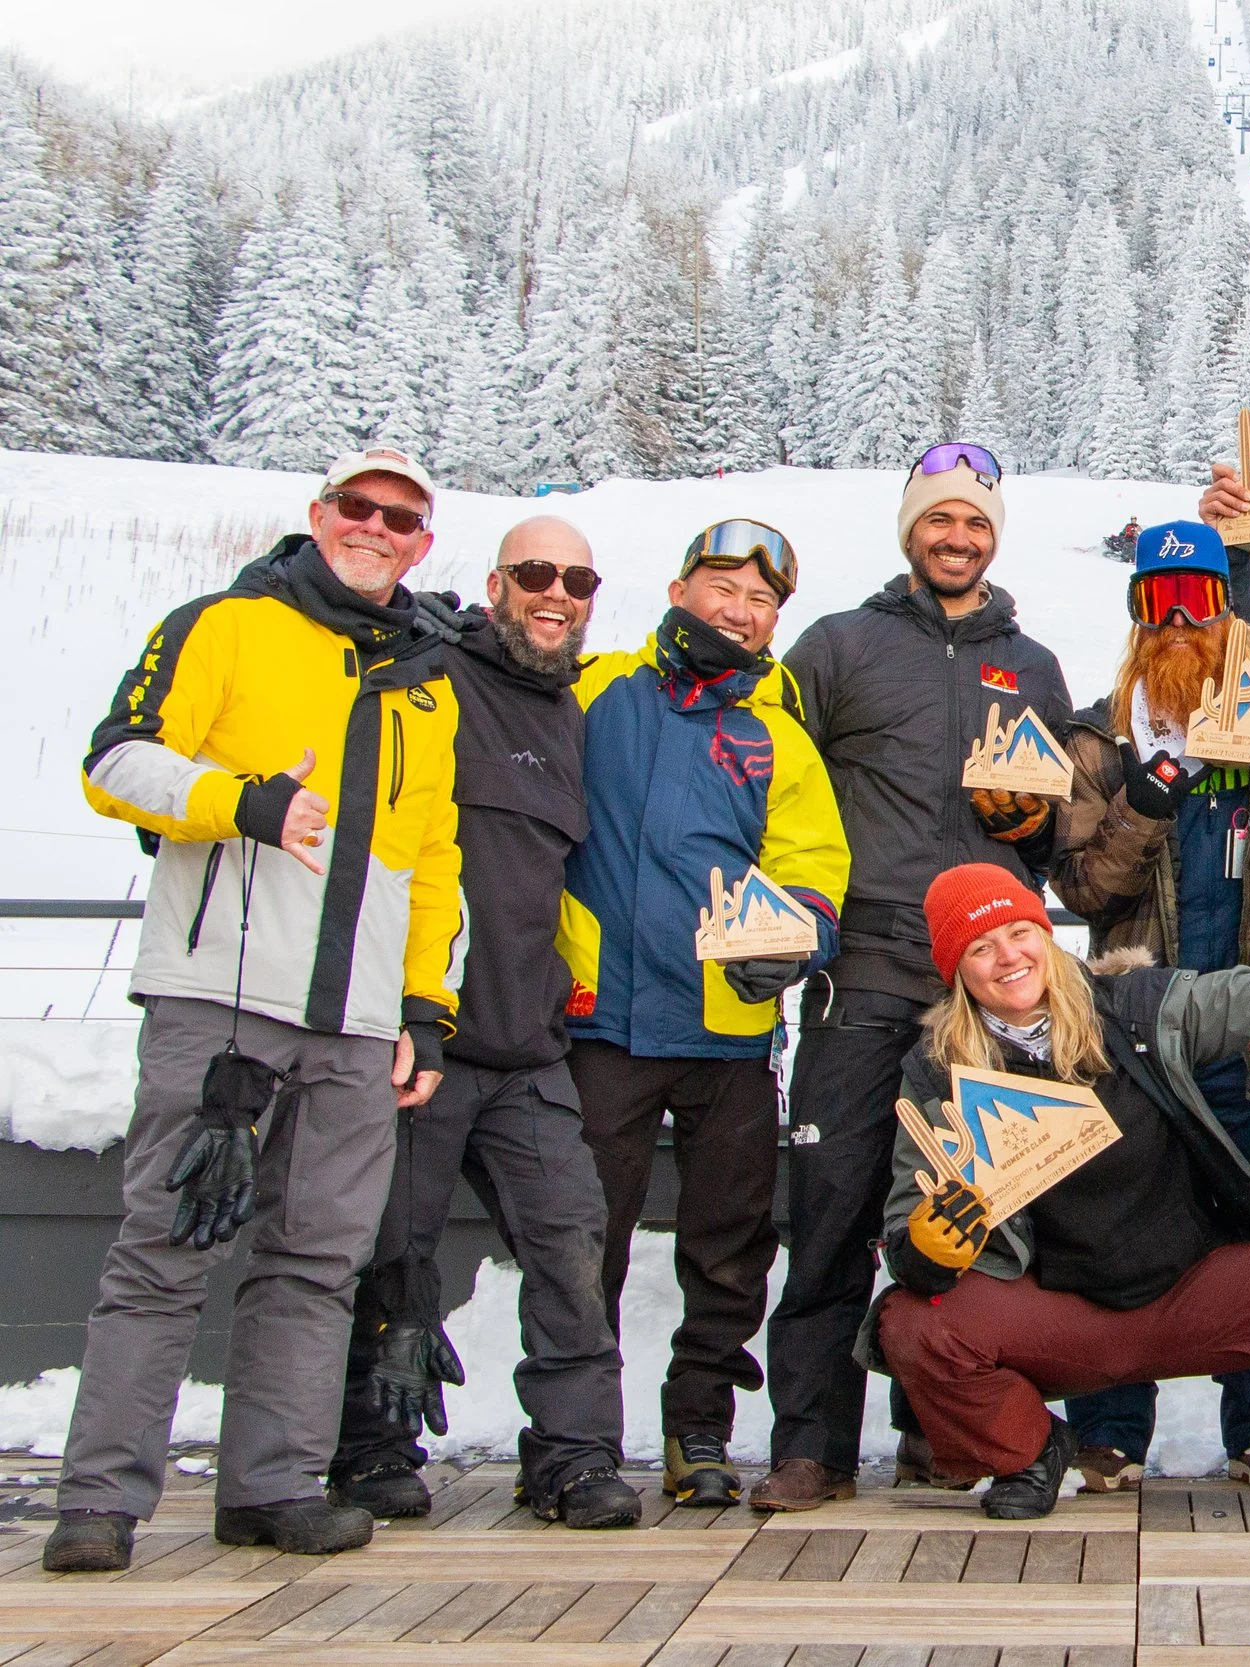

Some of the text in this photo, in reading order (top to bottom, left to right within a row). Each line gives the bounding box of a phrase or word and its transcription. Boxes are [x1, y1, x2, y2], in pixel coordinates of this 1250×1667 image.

[1146, 772, 1169, 794] TOYOTA
[967, 904, 991, 921] holy
[1035, 1139, 1076, 1172] LENZ
